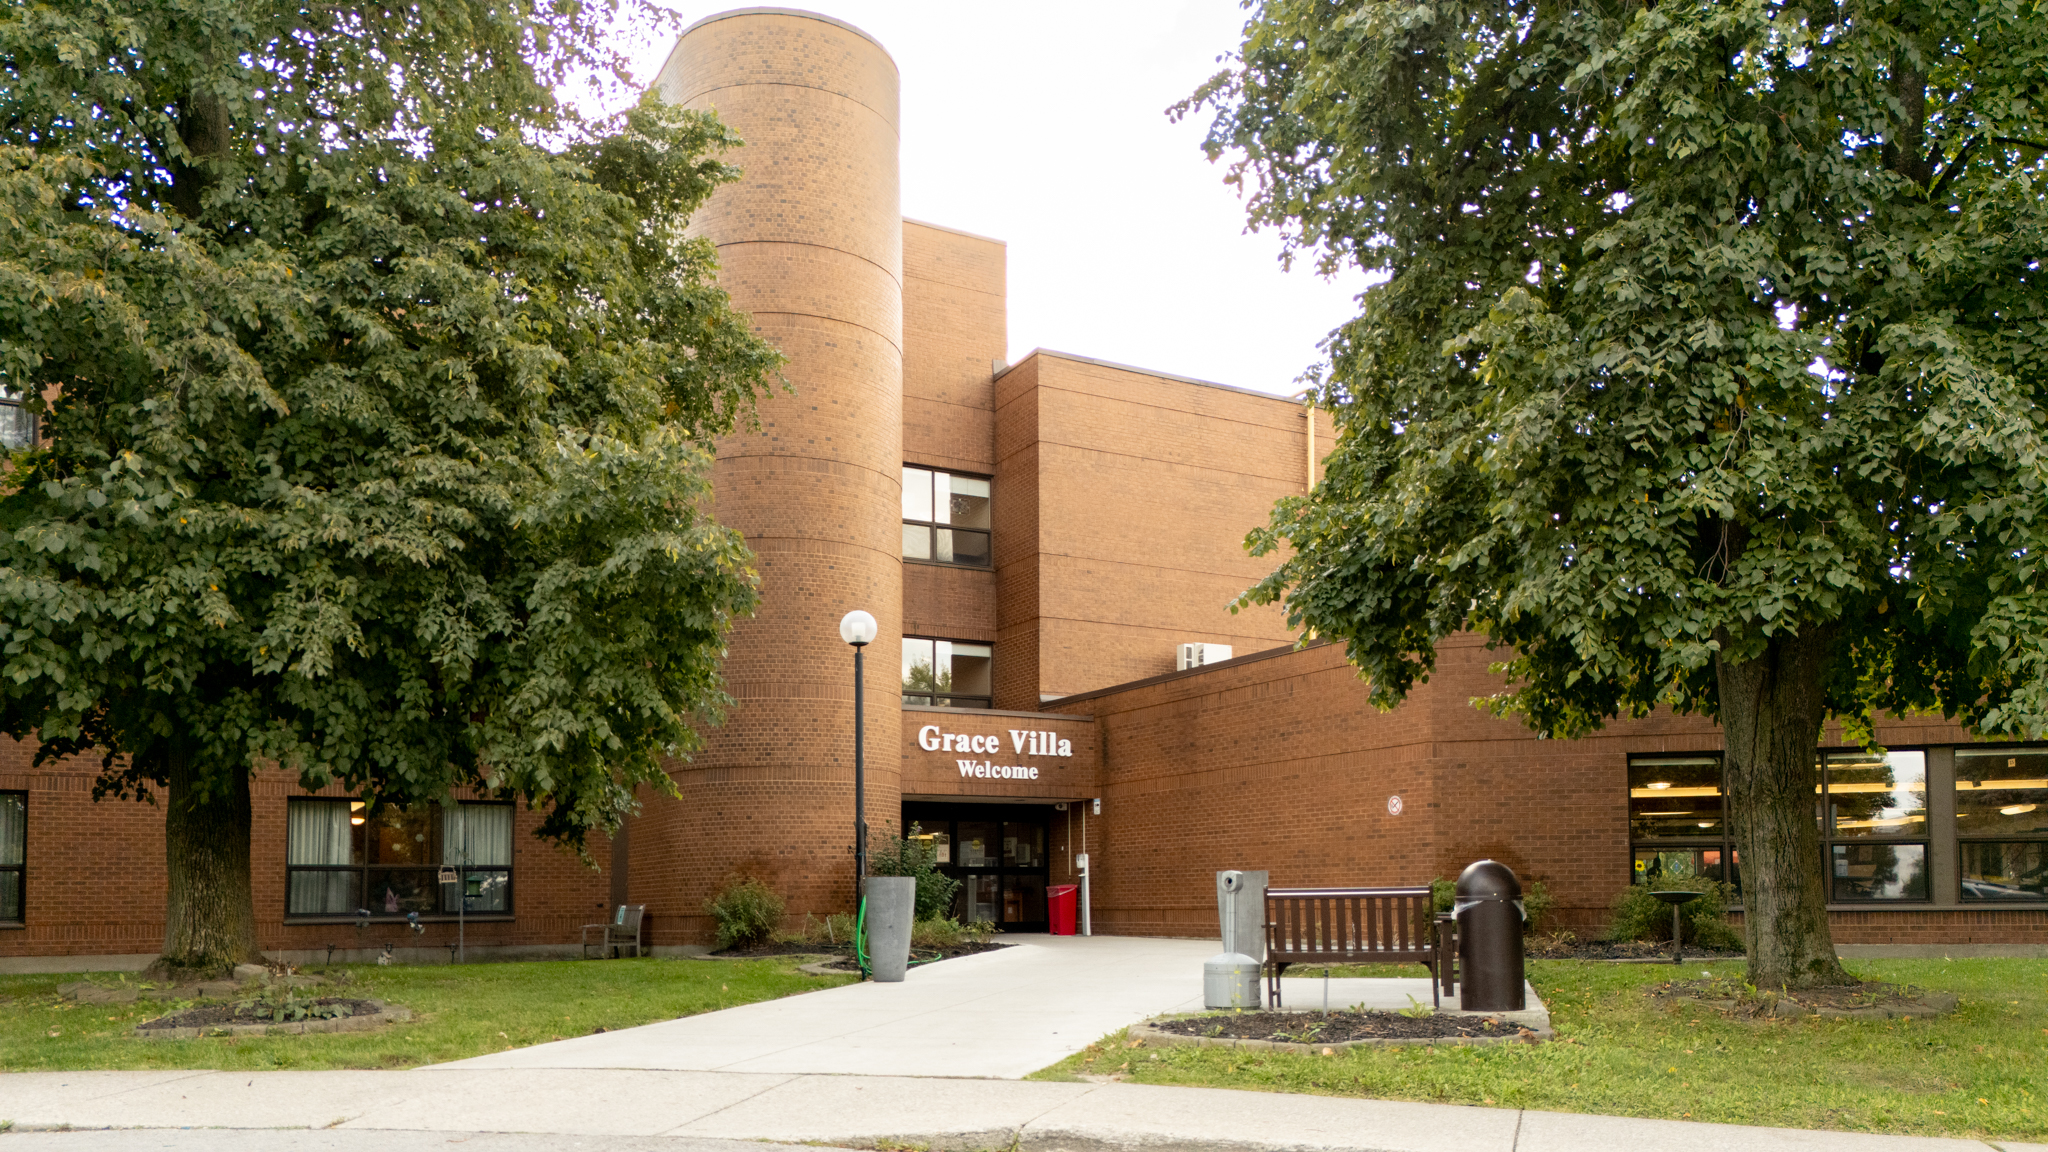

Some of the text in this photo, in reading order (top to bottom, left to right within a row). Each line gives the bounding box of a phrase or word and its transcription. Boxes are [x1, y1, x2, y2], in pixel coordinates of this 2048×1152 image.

[918, 725, 1072, 757] Grace Villa
[956, 759, 1039, 780] Welcome
